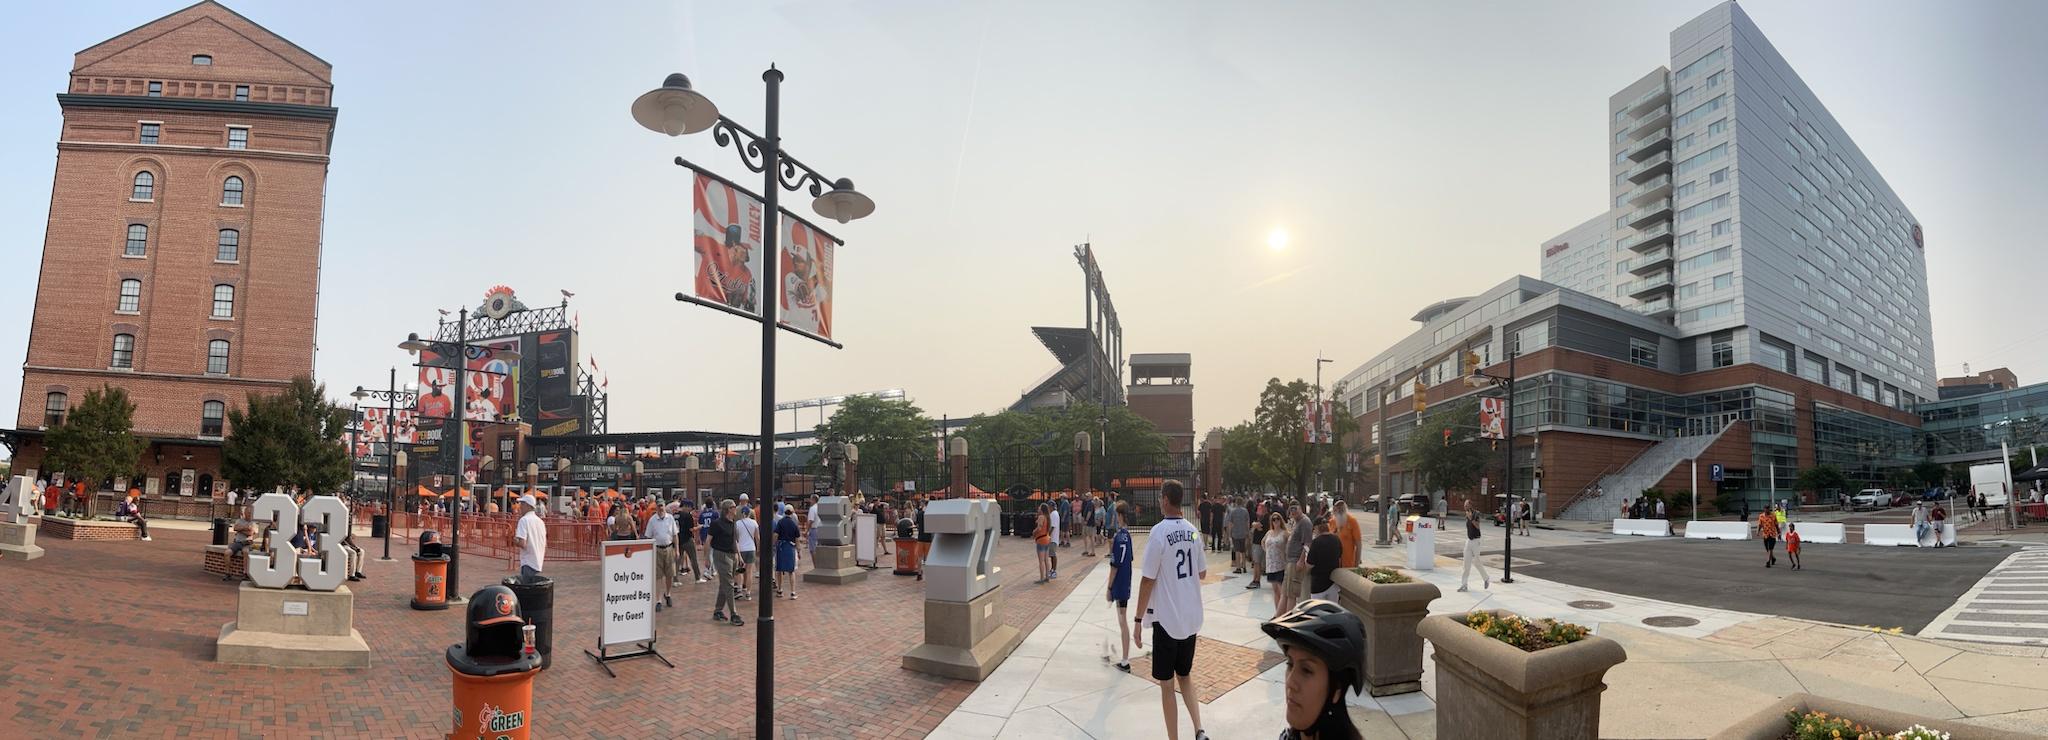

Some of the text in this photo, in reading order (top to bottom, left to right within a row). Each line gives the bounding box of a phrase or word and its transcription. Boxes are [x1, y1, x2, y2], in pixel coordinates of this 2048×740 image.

[749, 202, 761, 244] ADLEY
[1713, 465, 1720, 476] P
[248, 493, 350, 592] 33
[1120, 544, 1127, 563] 7
[1175, 548, 1193, 580] 21
[613, 571, 644, 584] Only One
[606, 590, 651, 604] Approved Bag
[612, 611, 644, 622] Per Guest
[490, 712, 523, 732] GREEN
